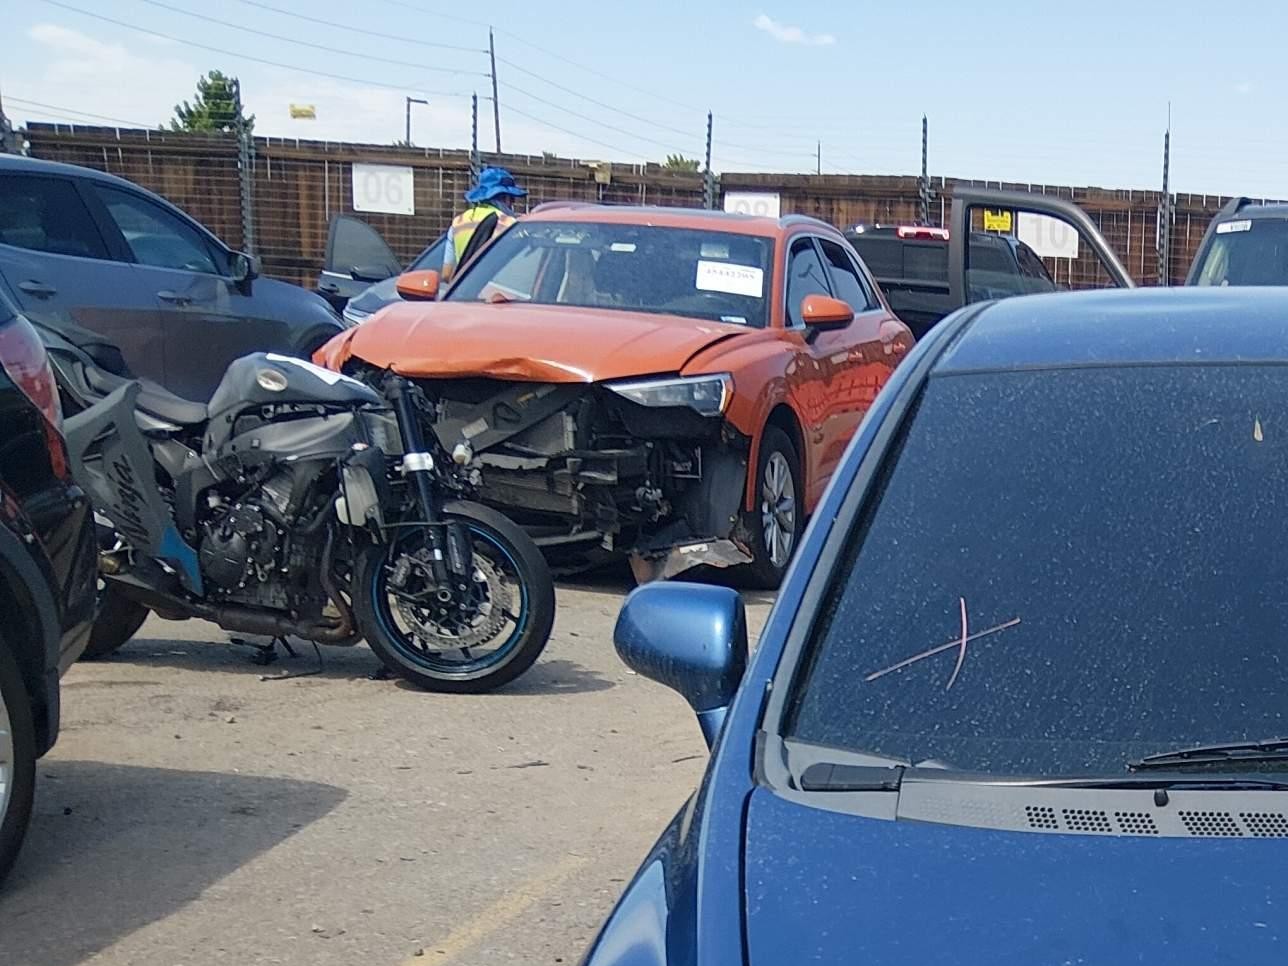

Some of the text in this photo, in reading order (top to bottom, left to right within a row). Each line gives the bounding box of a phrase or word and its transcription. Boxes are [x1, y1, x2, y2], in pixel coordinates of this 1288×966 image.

[363, 173, 403, 205] 06
[1030, 217, 1068, 249] 10
[106, 454, 151, 544] Ninja
